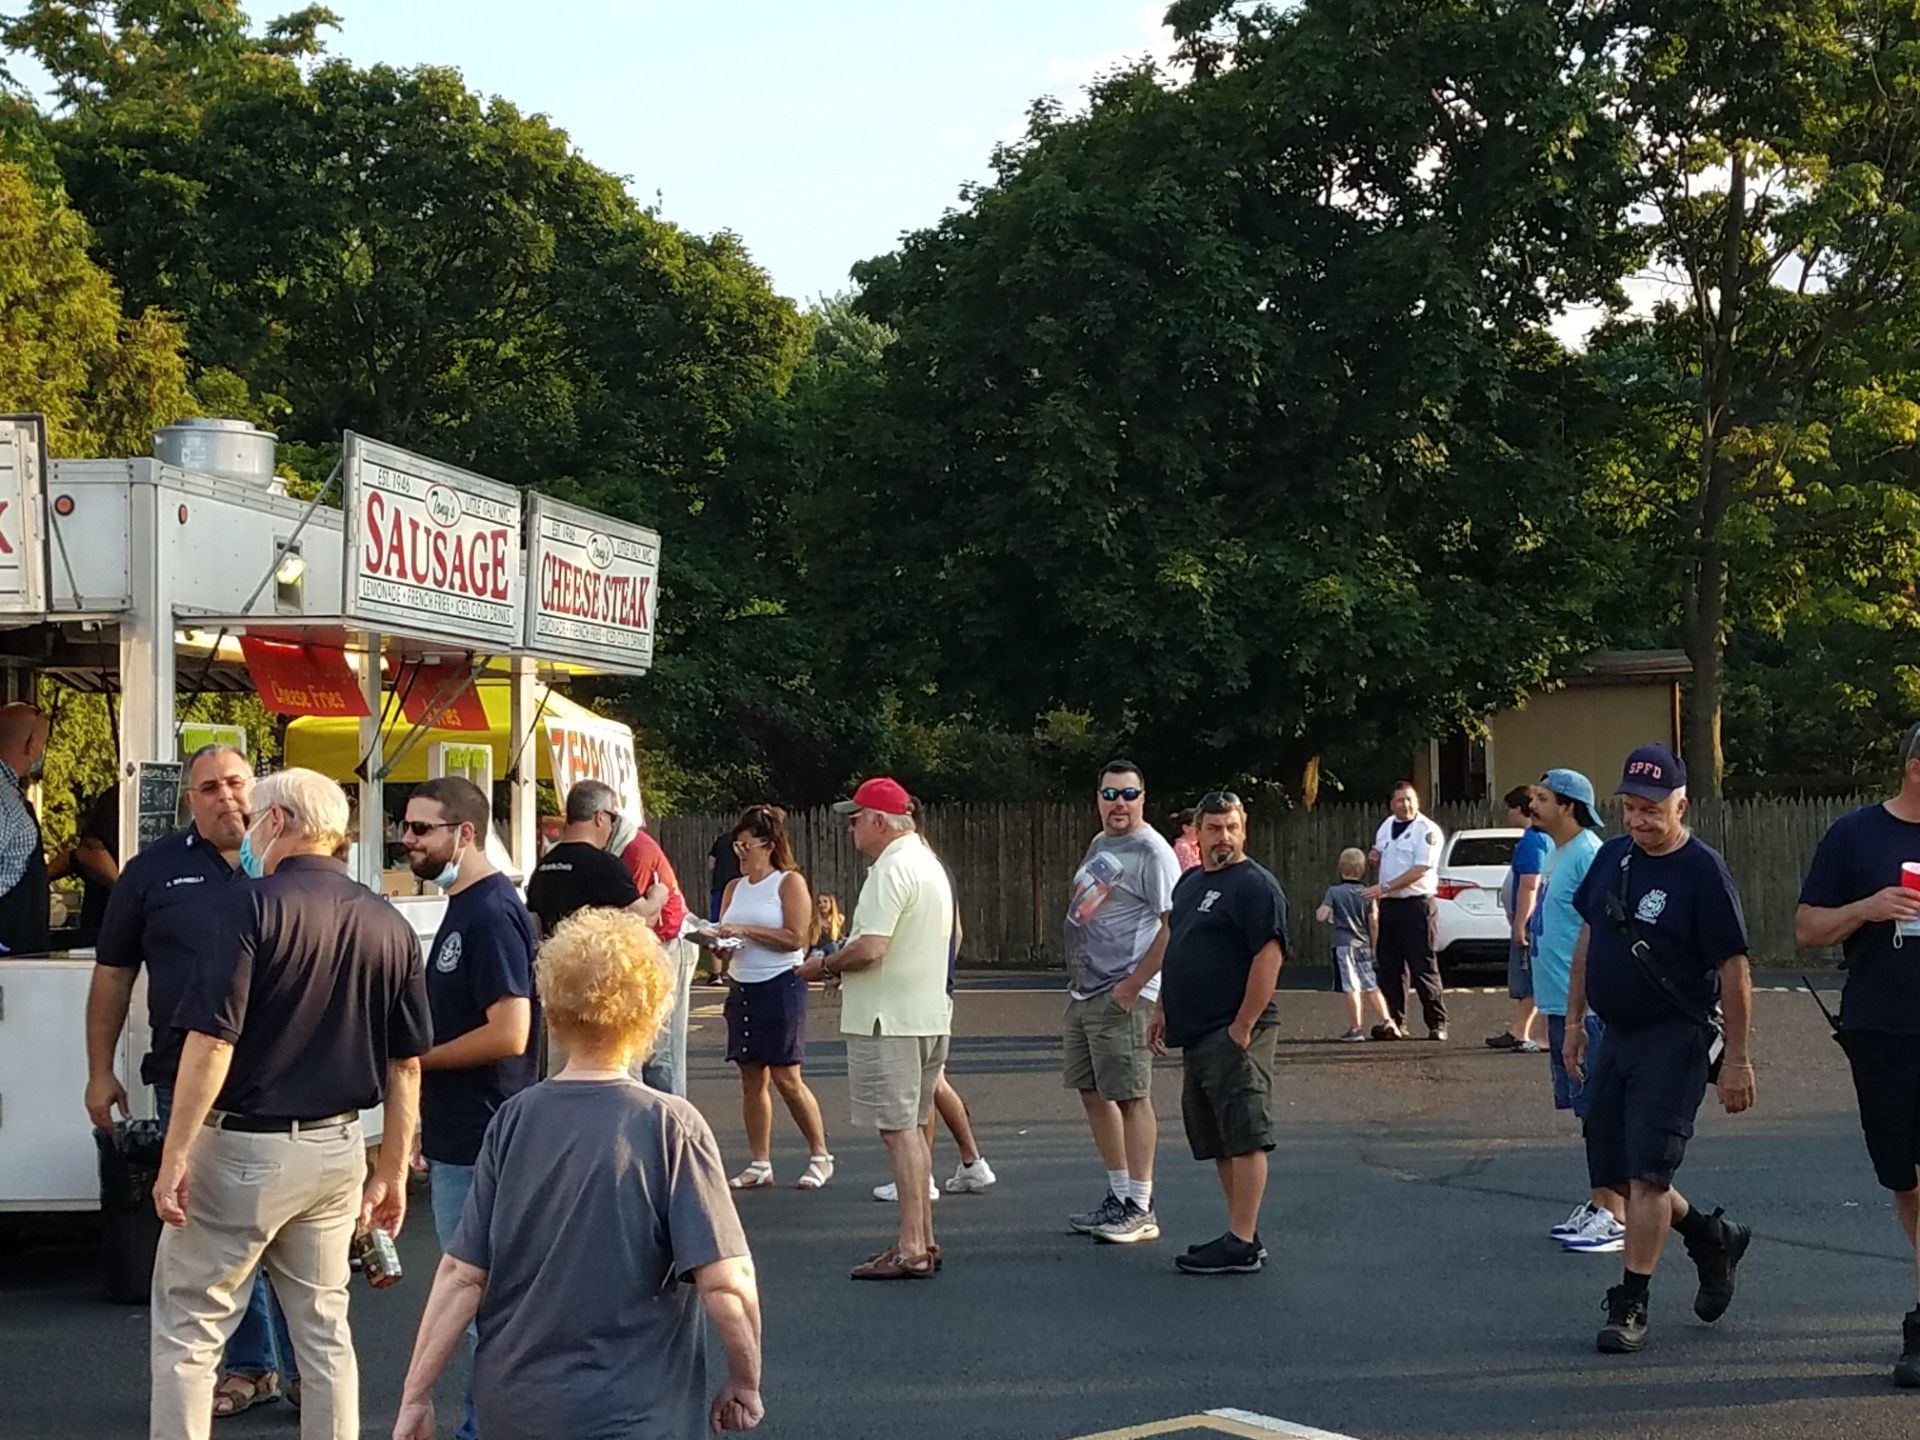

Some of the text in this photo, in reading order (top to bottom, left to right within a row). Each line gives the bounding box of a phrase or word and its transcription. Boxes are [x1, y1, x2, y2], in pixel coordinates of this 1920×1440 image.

[392, 471, 411, 493] 1946
[365, 490, 509, 601] SAUSAGE
[363, 579, 510, 624] LEMONADE FRENCH FRIES ICED COLD DRINKS
[1628, 761, 1662, 779] SPFD
